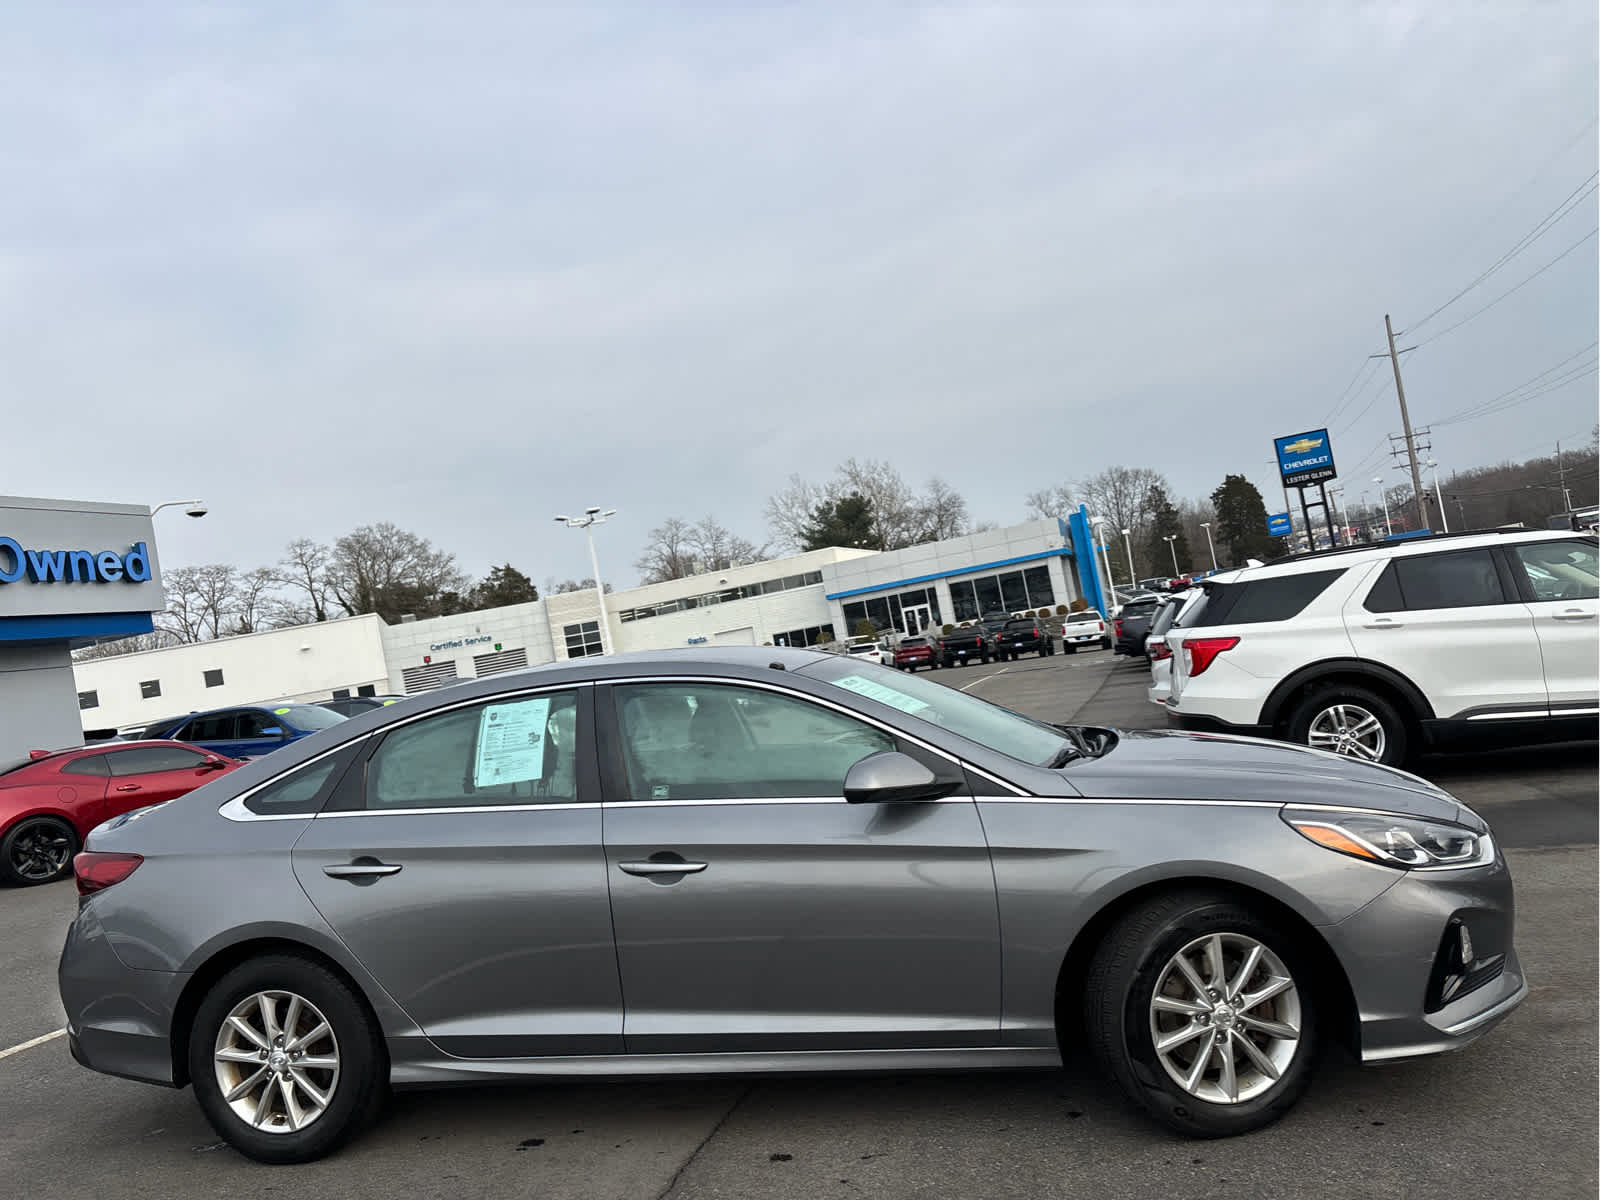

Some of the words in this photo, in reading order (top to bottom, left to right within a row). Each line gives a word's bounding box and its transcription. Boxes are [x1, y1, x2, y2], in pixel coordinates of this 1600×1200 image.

[1284, 456, 1328, 470] CHEVROLET
[1287, 474, 1309, 484] LESTER
[1311, 470, 1333, 479] GLENN
[0, 536, 152, 583] Owned
[430, 640, 463, 651] Certified
[465, 635, 492, 645] Service
